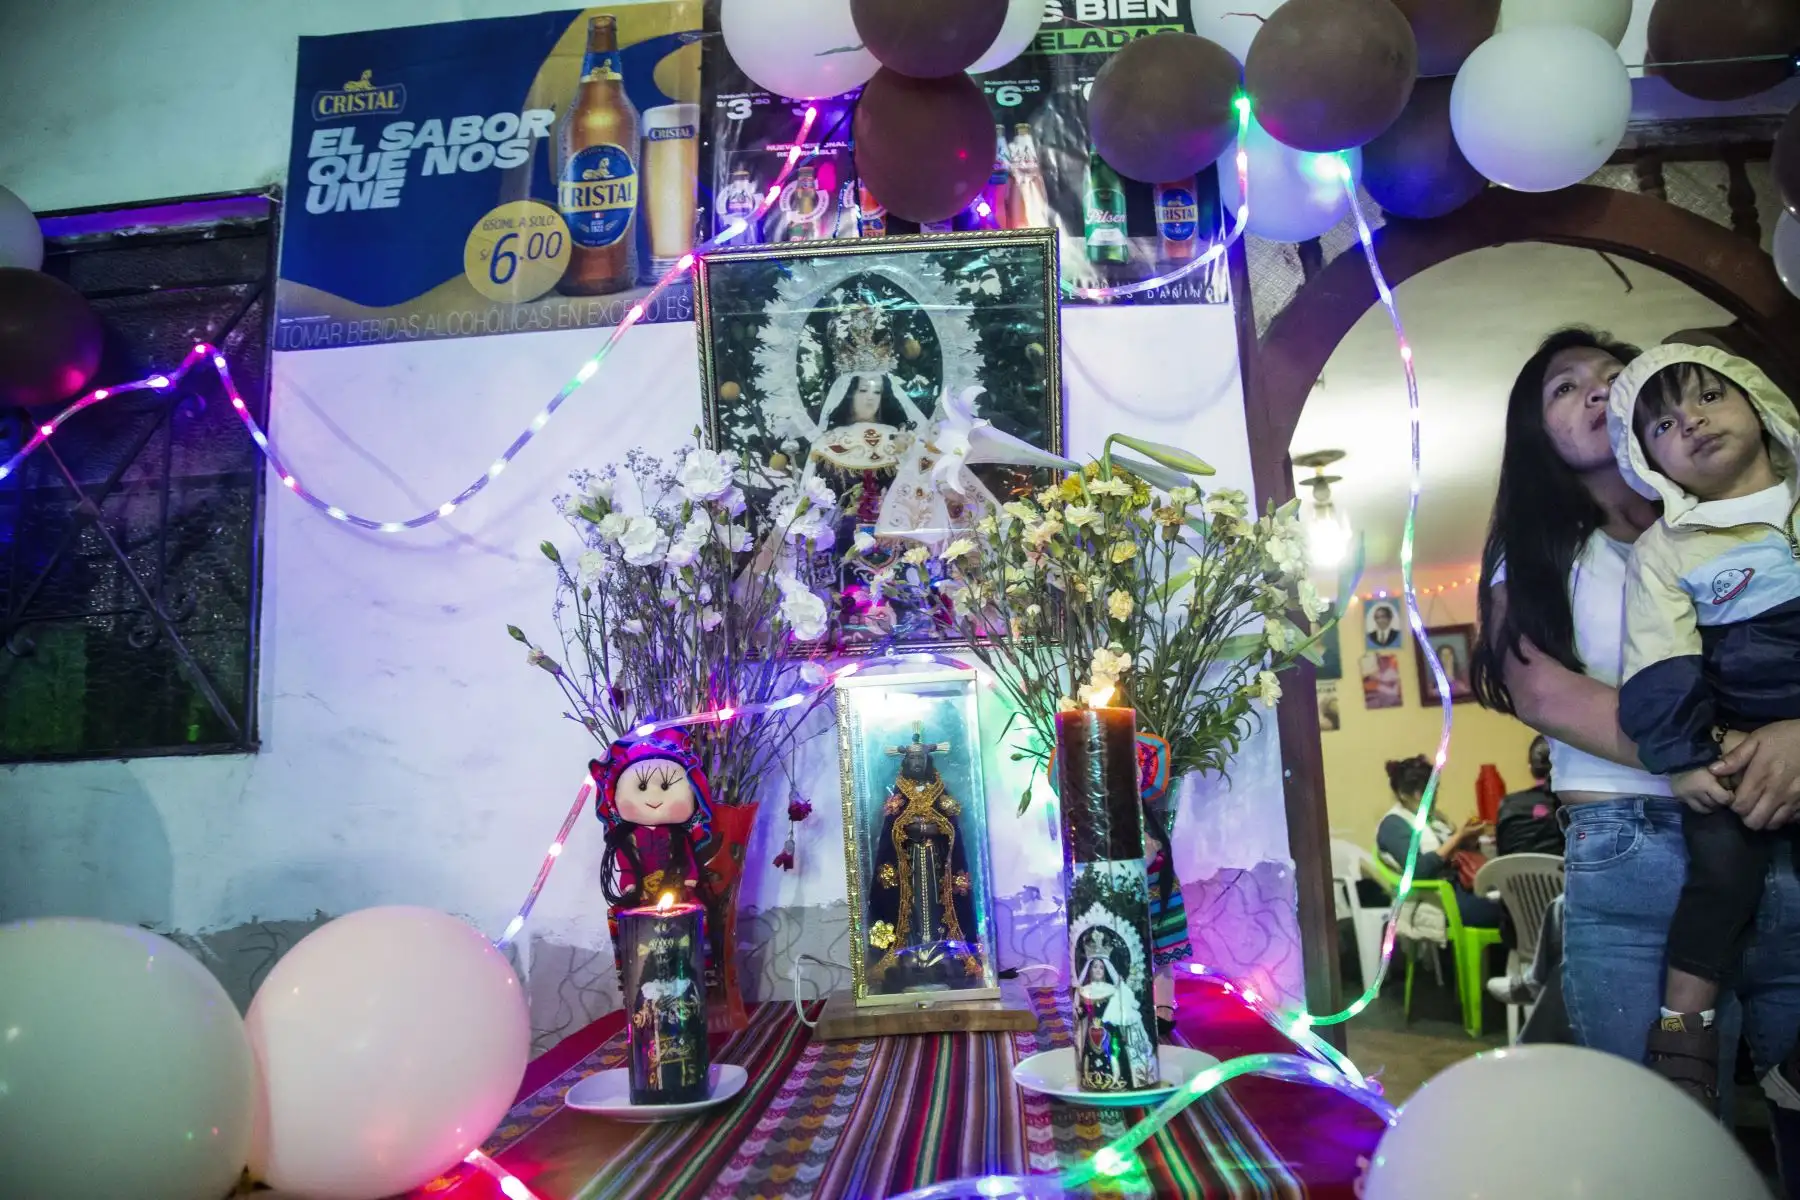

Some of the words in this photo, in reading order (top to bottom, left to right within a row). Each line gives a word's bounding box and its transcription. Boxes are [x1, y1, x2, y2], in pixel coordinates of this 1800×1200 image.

[1076, 0, 1178, 21] BIEN
[318, 91, 399, 115] CRISTAL
[307, 127, 364, 158] EL
[379, 109, 556, 150] SABOR
[651, 127, 690, 140] CRISTAL
[307, 149, 411, 186] QUE
[421, 138, 530, 176] NOS
[305, 179, 405, 215] UNE
[562, 181, 633, 208] CRISTAL
[1085, 206, 1127, 225] Pilsen
[281, 322, 342, 349] TOMAR
[346, 314, 420, 344] BEBIDAS
[558, 303, 582, 328] EN
[666, 296, 690, 320] ES
